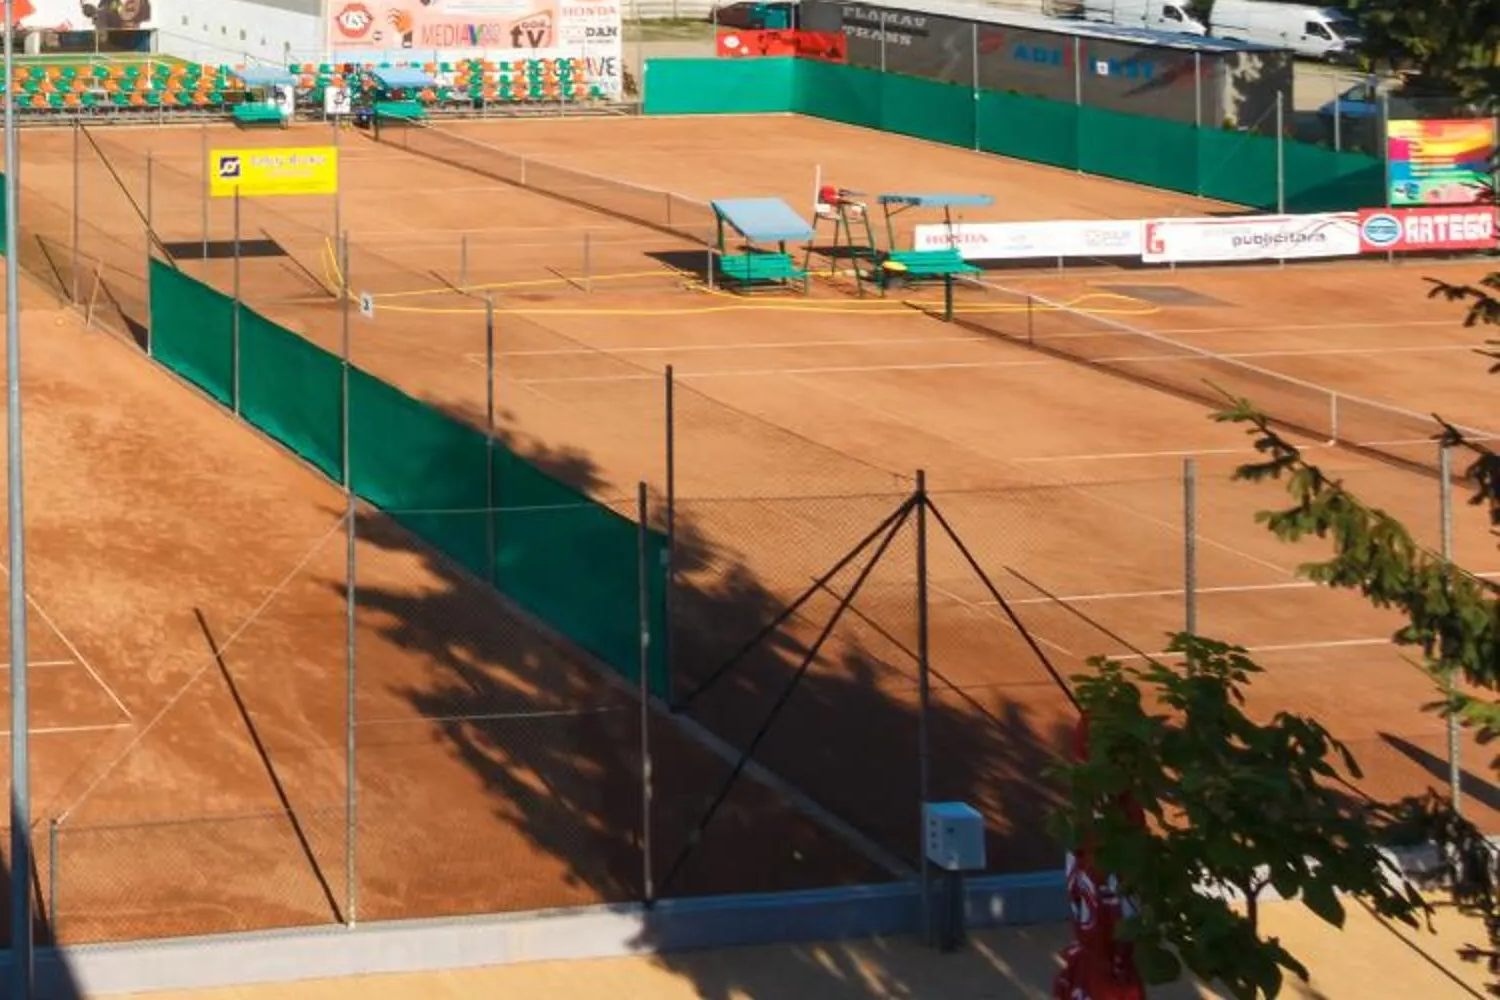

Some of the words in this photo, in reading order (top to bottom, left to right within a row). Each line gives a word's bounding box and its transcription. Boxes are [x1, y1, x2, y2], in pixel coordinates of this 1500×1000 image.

[562, 6, 617, 17] HONDA
[1404, 213, 1493, 244] ARTEGO
[925, 233, 989, 245] HONDA
